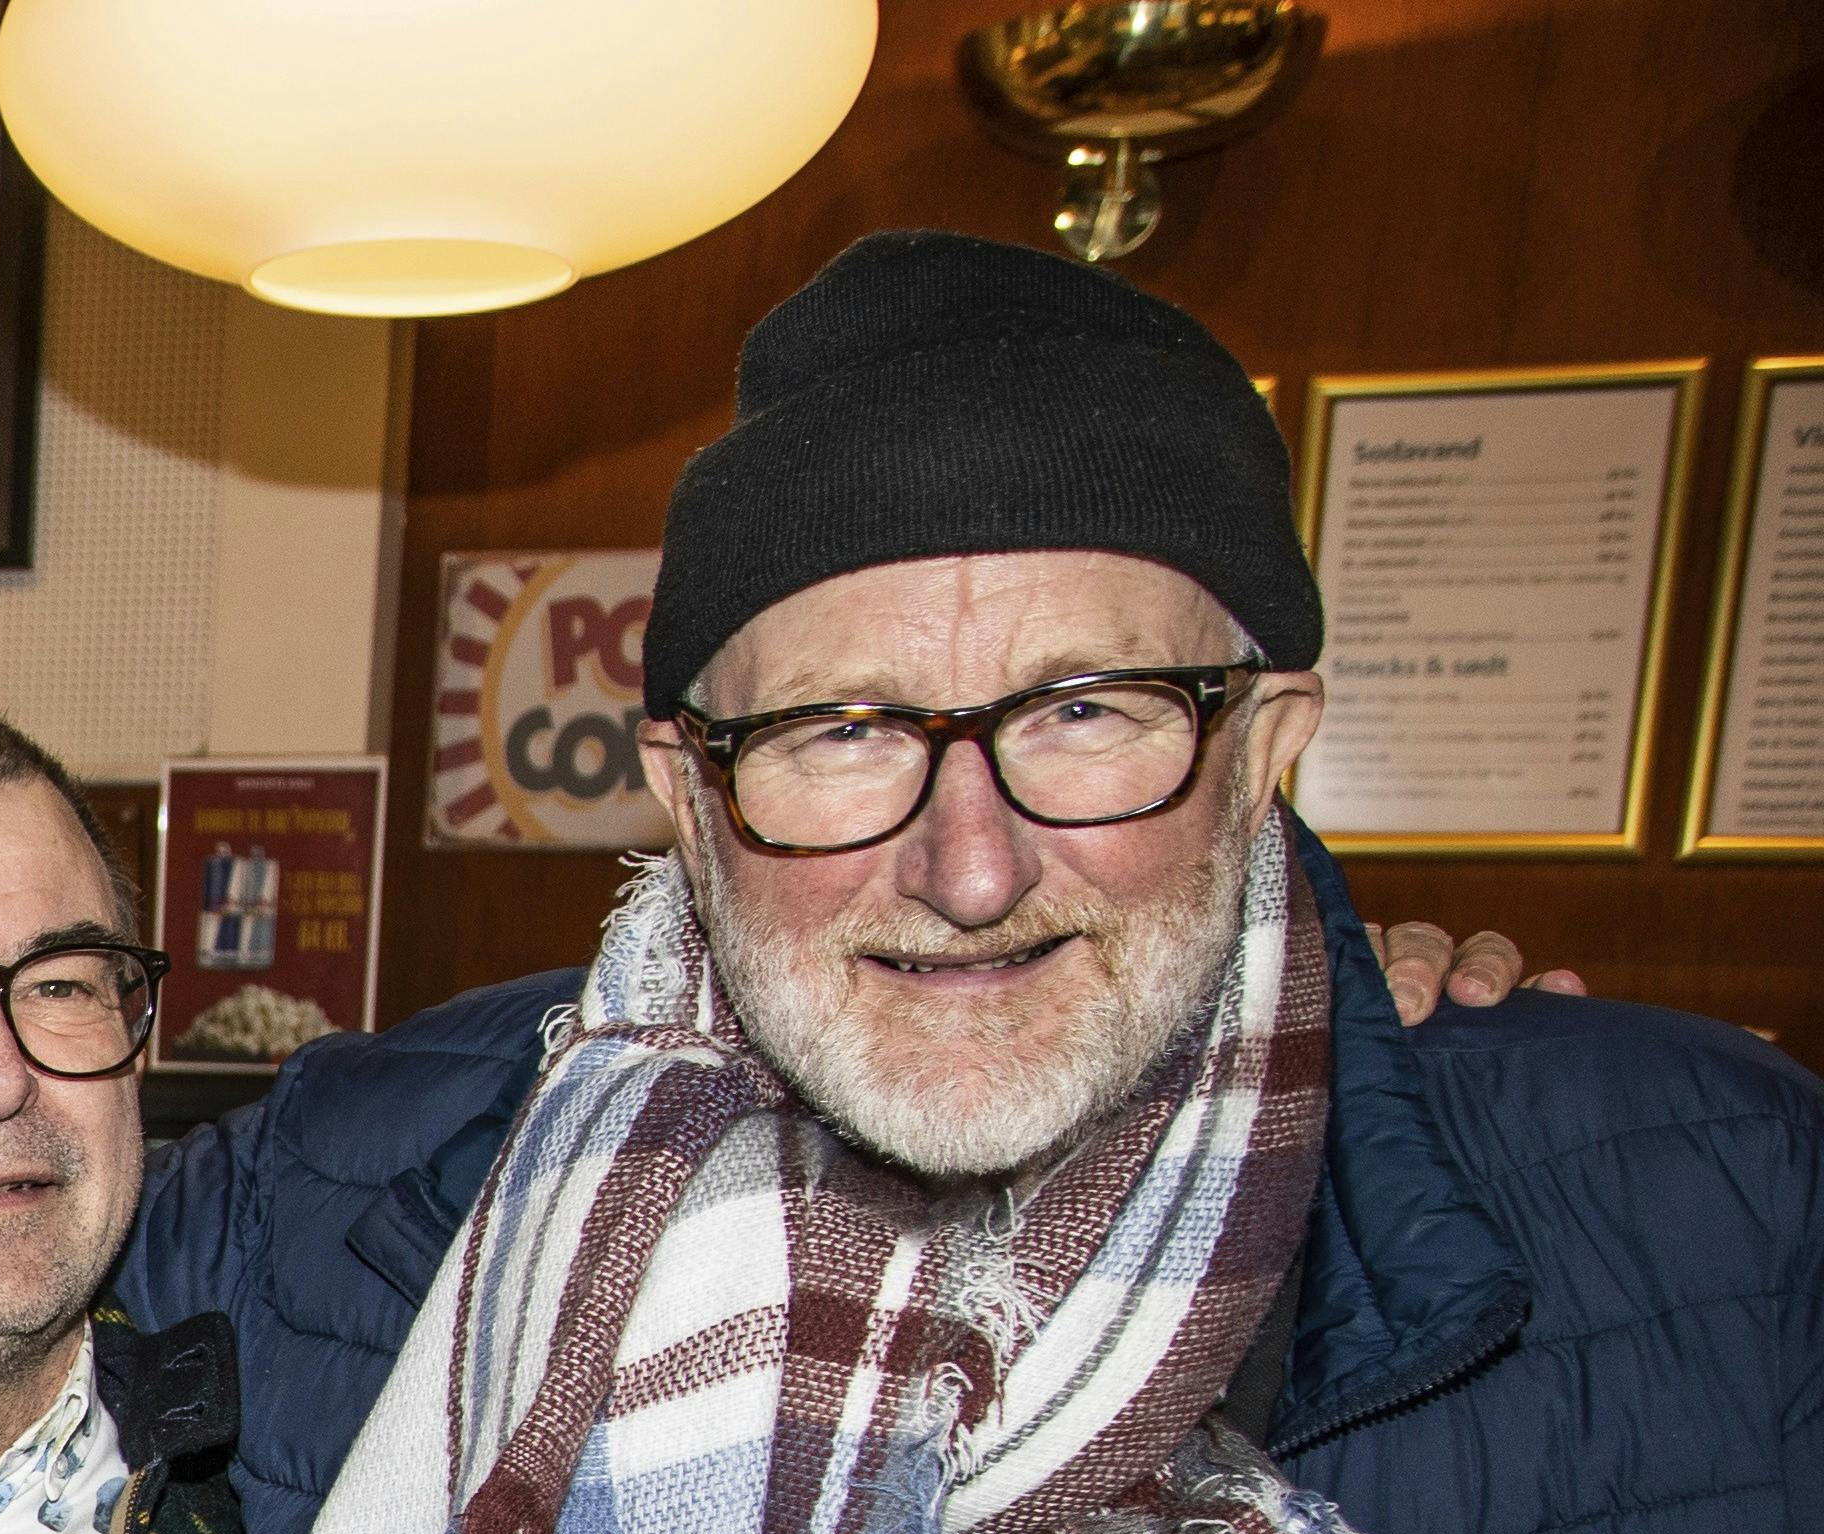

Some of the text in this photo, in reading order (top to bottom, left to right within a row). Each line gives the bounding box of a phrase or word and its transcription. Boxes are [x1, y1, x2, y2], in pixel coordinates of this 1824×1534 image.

[1355, 434, 1483, 464] Sodavand
[1332, 653, 1417, 679] Snacks
[1424, 654, 1444, 678] &
